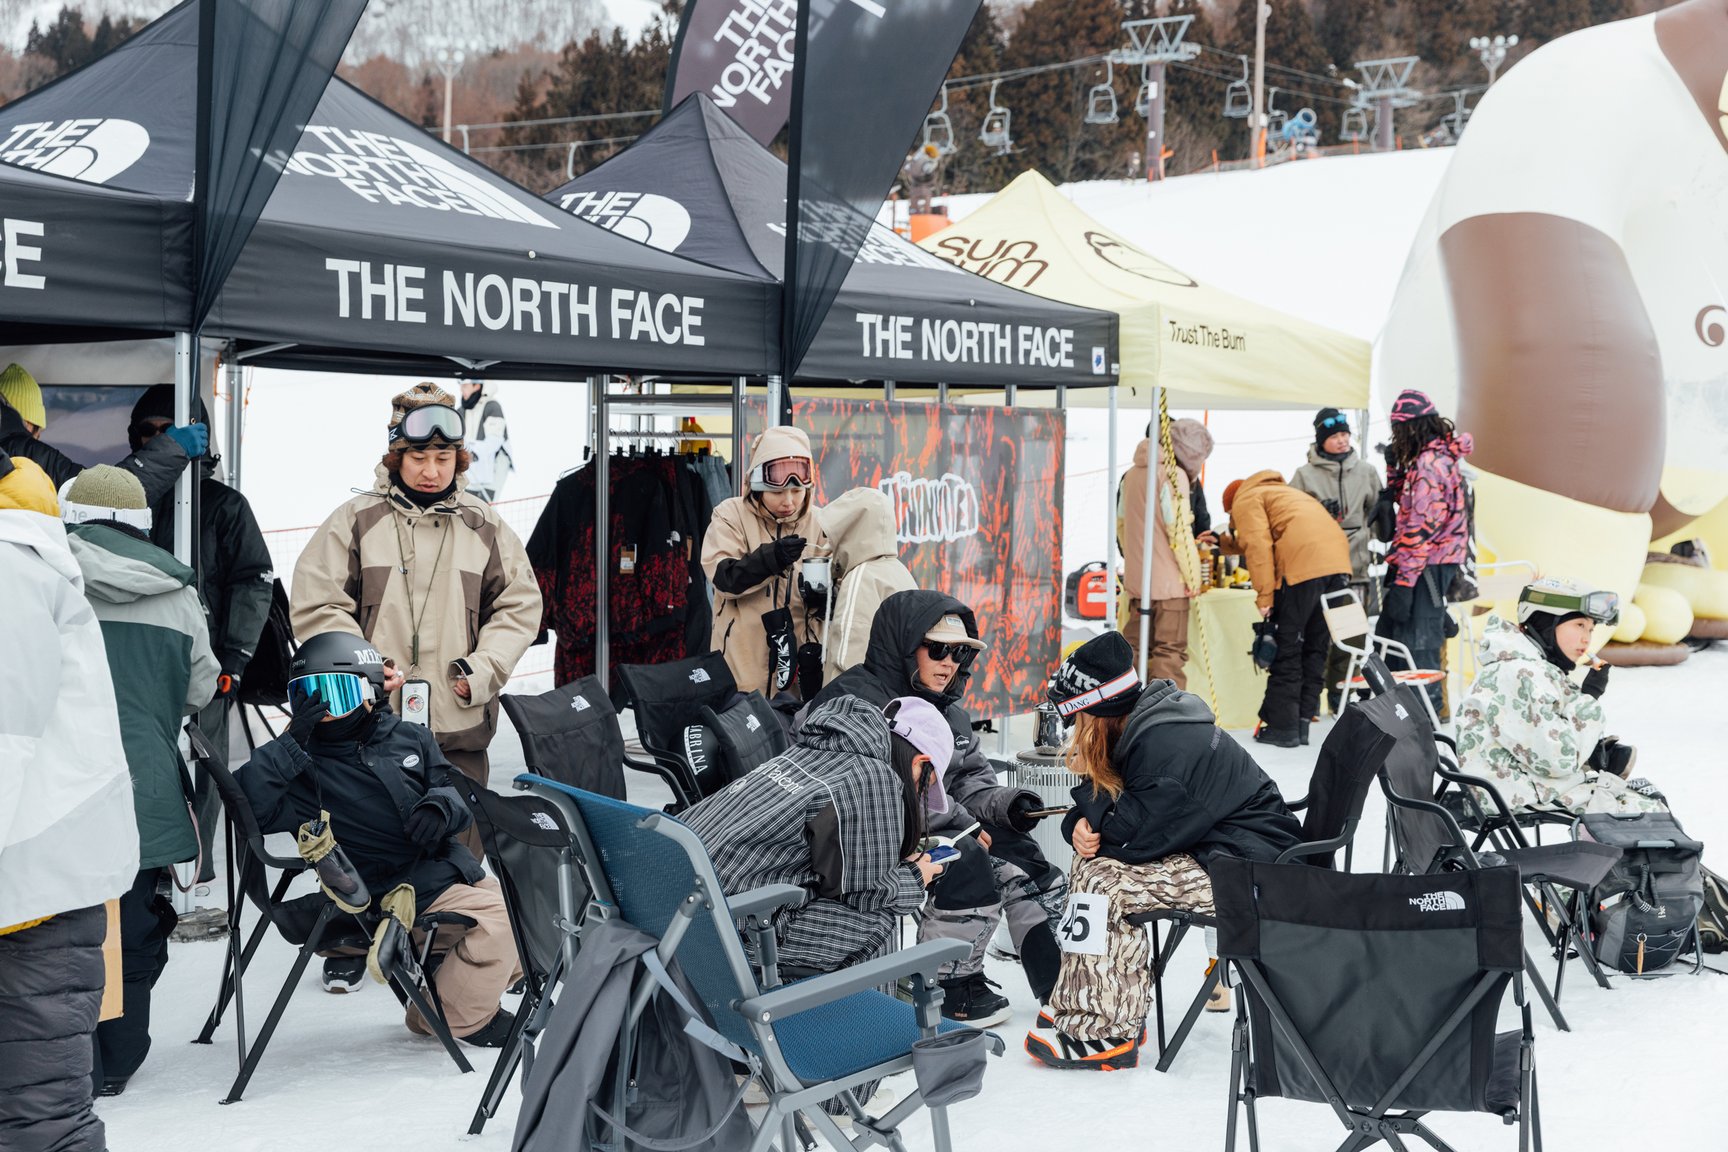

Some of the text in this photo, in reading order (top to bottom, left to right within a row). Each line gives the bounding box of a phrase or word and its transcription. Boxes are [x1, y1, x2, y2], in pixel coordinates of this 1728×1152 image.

[713, 0, 773, 47] TH
[746, 19, 798, 105] FAC
[0, 118, 104, 153] THE
[296, 124, 415, 163] THE
[250, 147, 450, 191] NORTH
[338, 177, 484, 216] FACE
[559, 191, 642, 216] THE
[937, 236, 1038, 262] sun
[325, 258, 705, 346] THE NORTH FACE
[856, 313, 1075, 368] THE NORTH FACE
[1169, 320, 1246, 351] Trust The Bum
[1408, 896, 1446, 905] NORTH
[1420, 903, 1447, 912] FACE
[1422, 891, 1444, 900] THE
